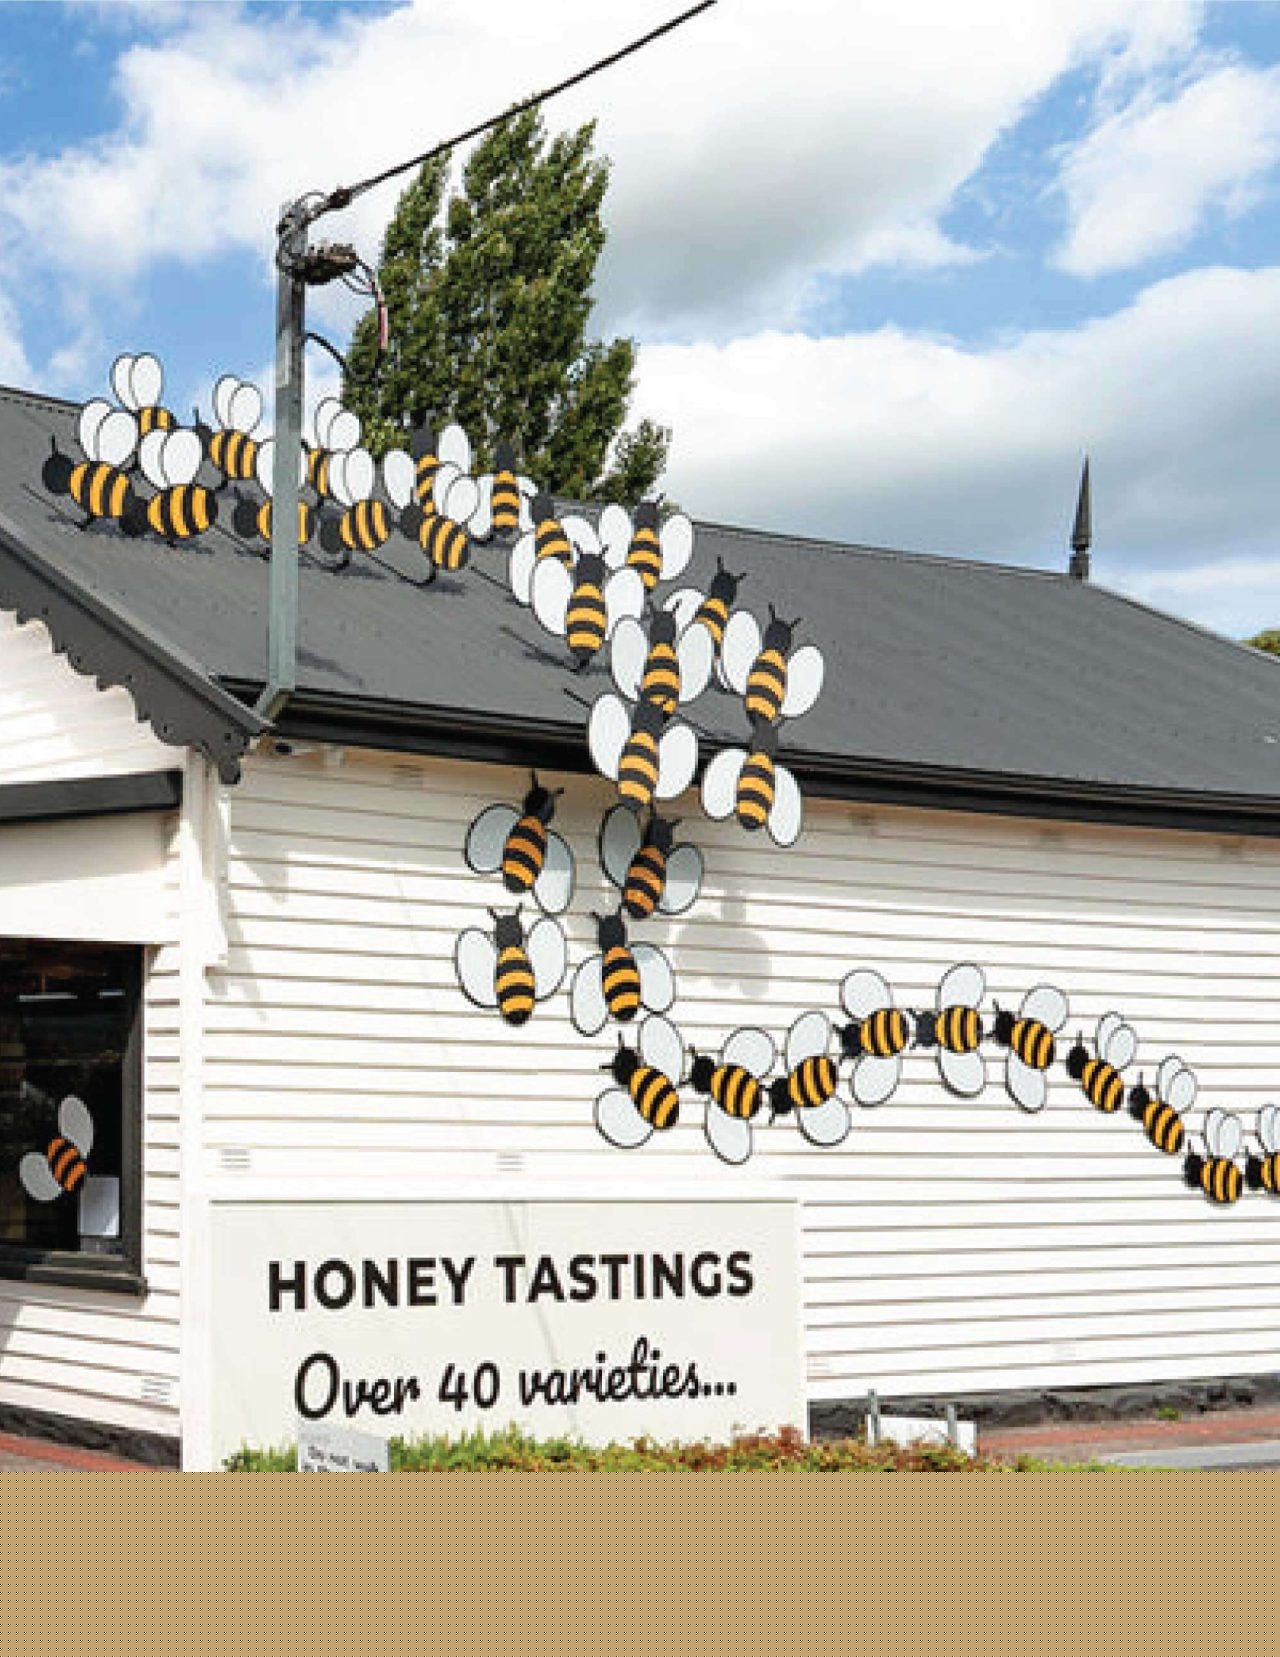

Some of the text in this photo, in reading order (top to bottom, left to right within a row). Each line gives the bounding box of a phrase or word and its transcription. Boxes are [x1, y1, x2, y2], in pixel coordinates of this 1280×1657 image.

[268, 1250, 755, 1313] HONEY TASTINGS
[294, 1336, 738, 1421] Over 40 varieties...
